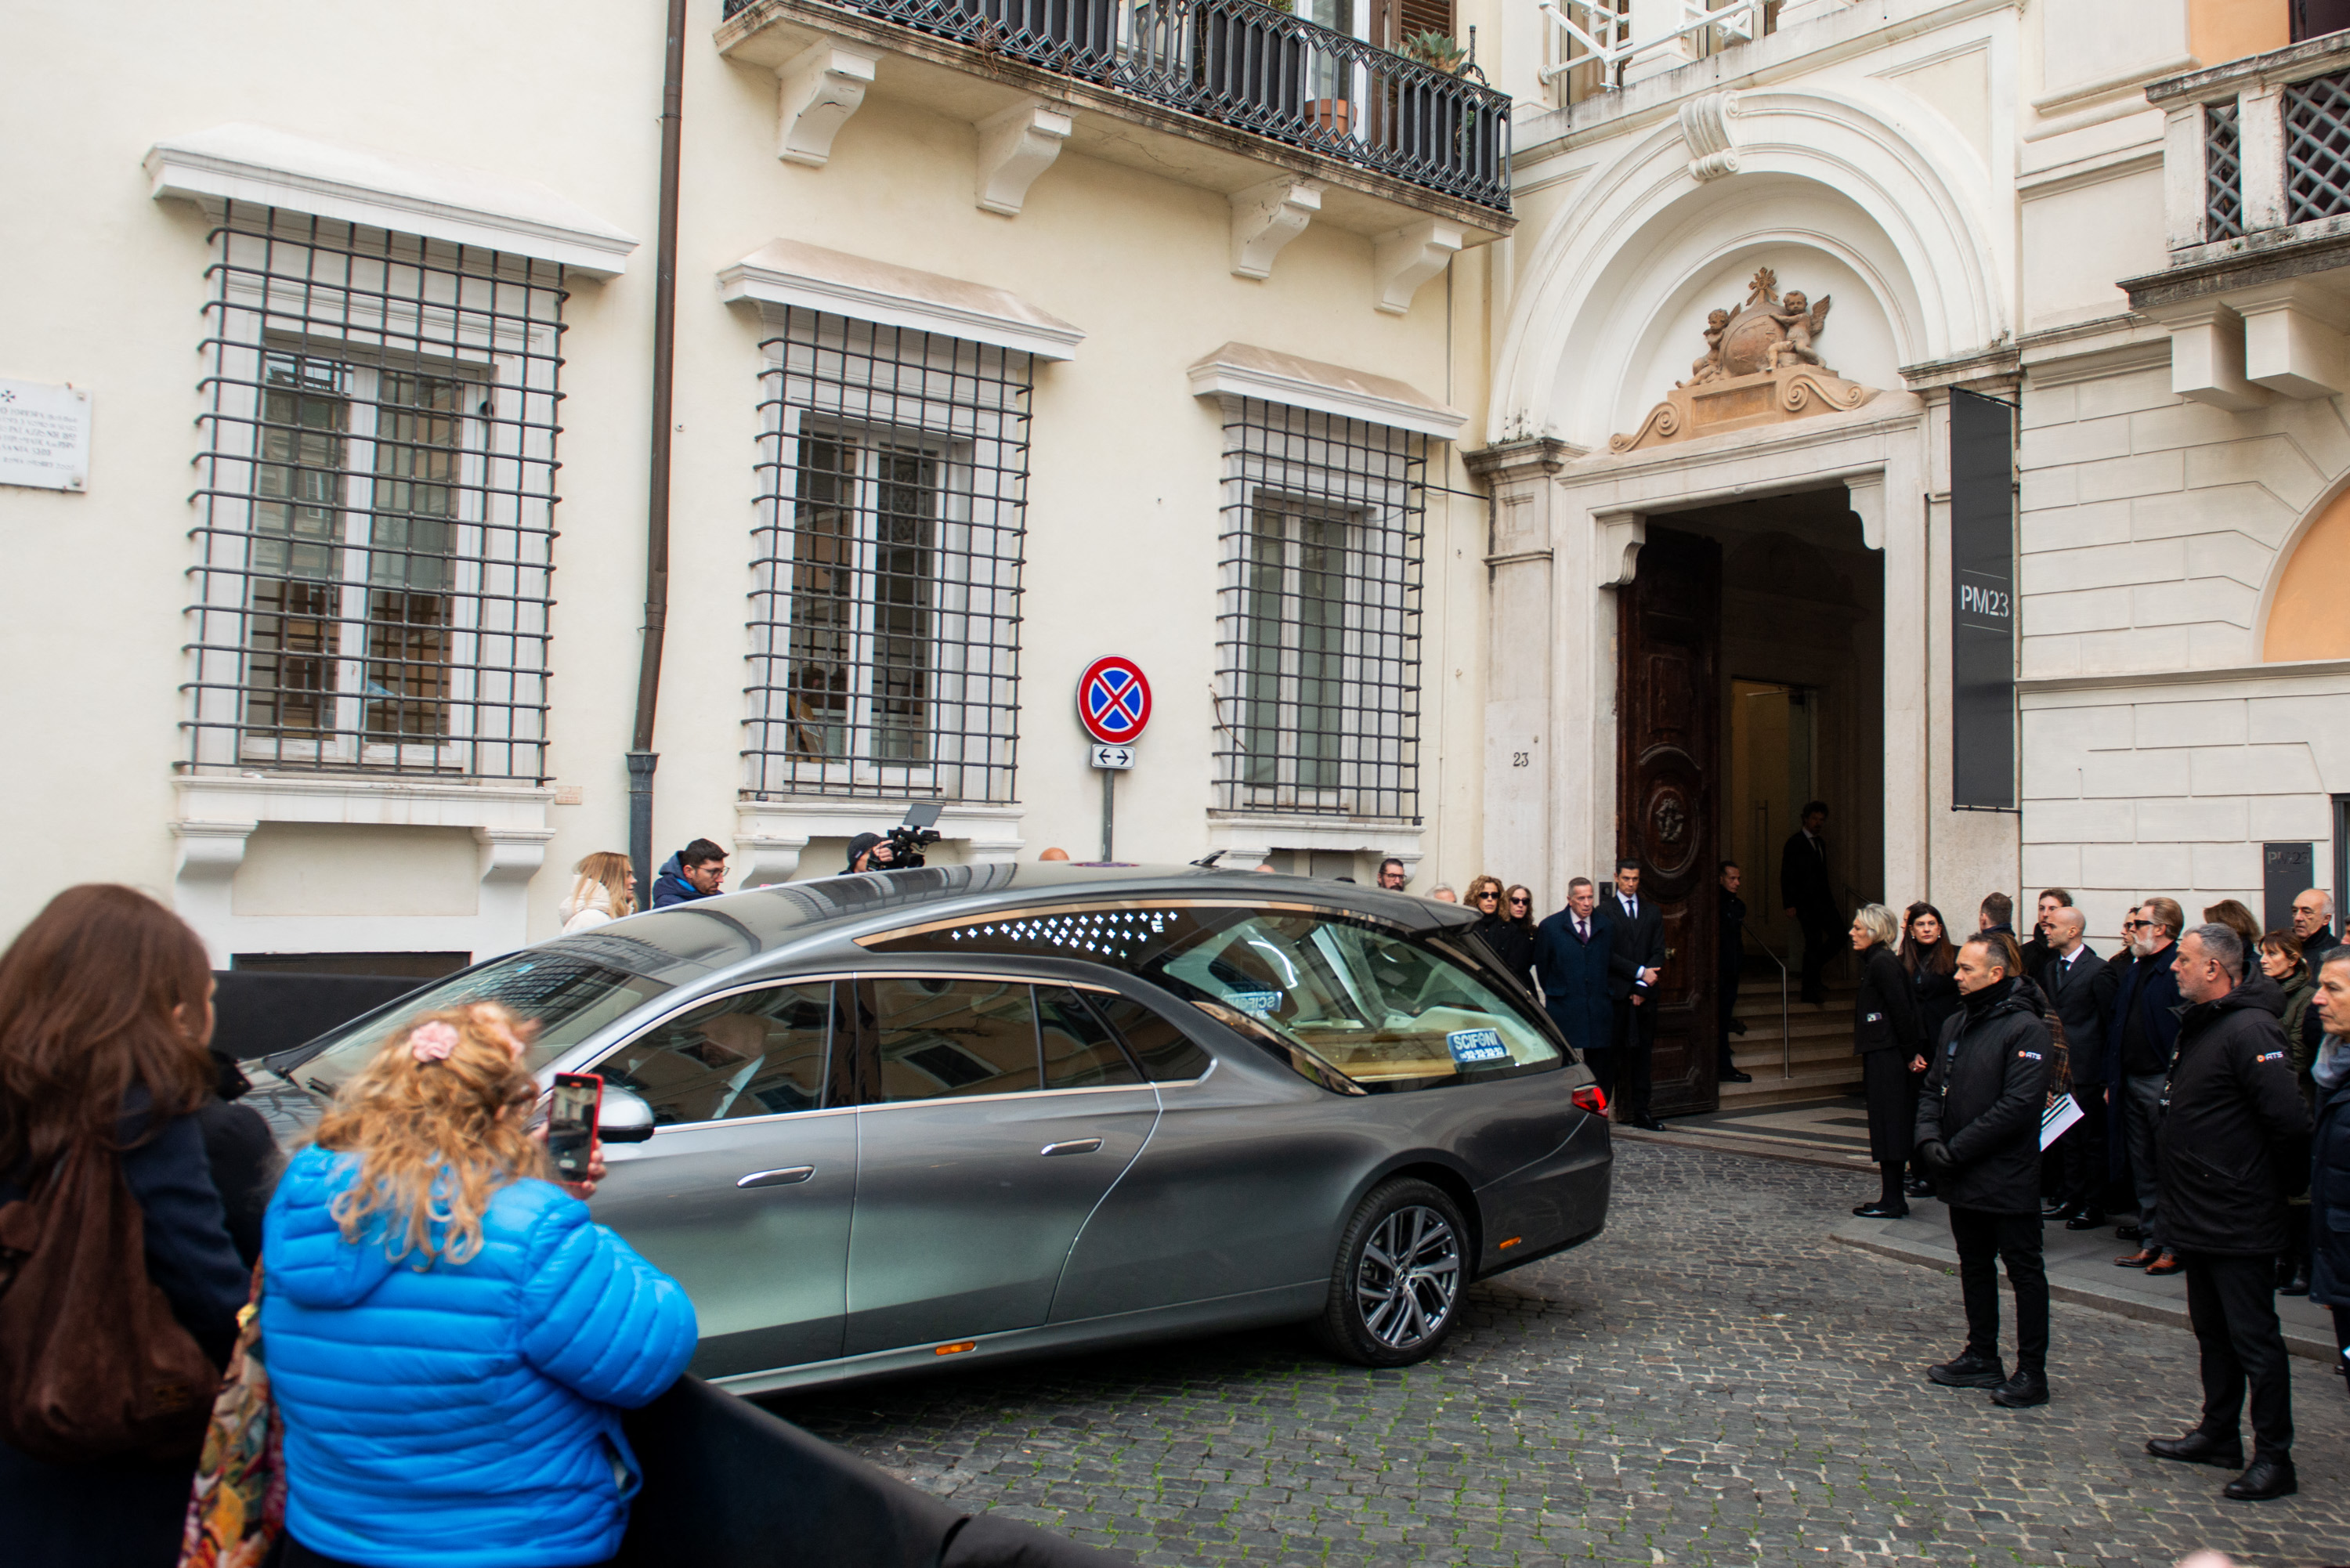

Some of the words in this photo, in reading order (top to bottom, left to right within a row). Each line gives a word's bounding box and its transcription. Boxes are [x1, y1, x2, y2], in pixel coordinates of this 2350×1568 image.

[1961, 584, 2009, 617] PM23
[1513, 752, 1529, 767] 23
[1453, 1032, 1498, 1050] SCIFONI
